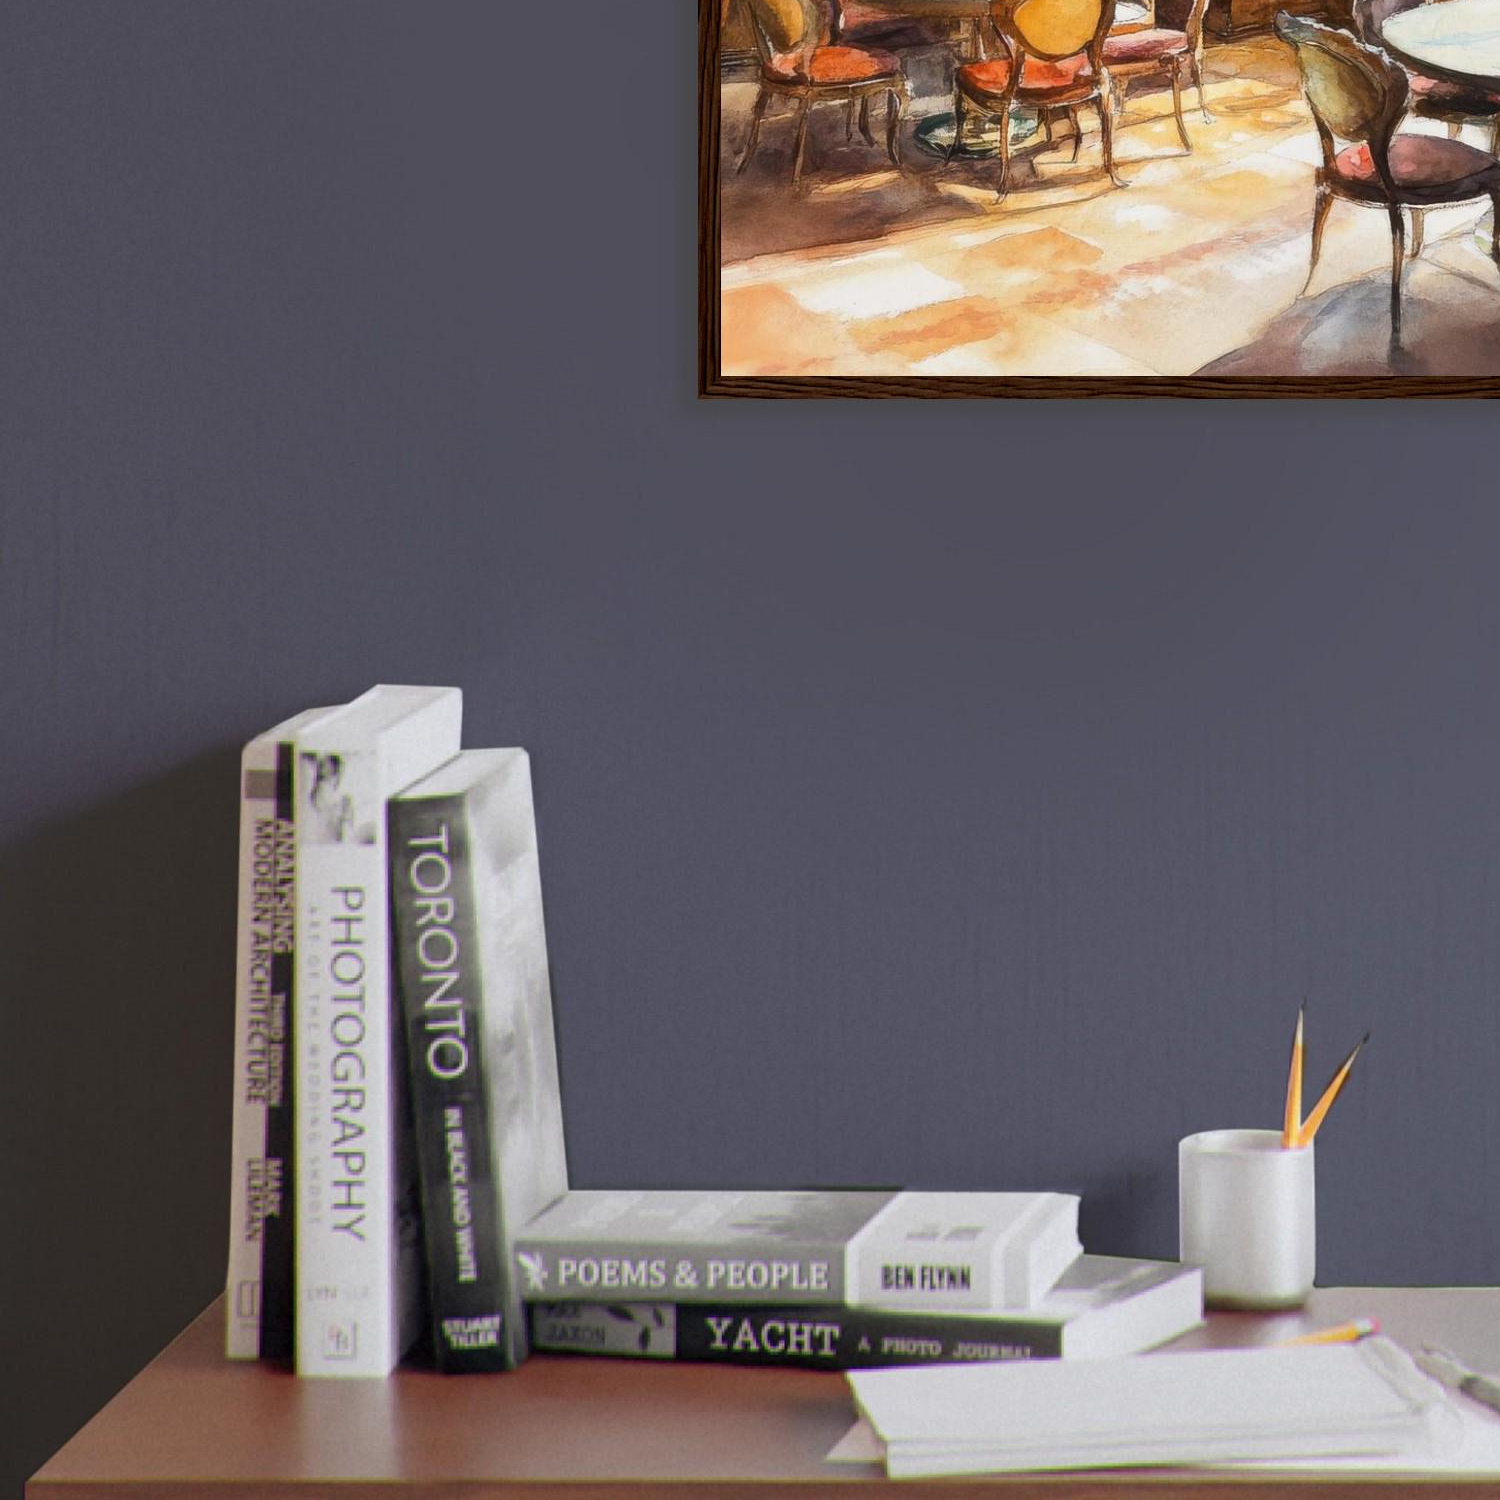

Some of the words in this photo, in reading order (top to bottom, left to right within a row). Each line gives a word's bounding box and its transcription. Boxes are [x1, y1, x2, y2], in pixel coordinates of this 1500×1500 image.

[252, 819, 274, 924] MODERN
[407, 824, 469, 1080] TORONTO
[246, 931, 272, 1105] ARCHITECTURE
[330, 885, 367, 1242] PHOTOGRAPHY
[557, 1258, 667, 1289] POEMS
[674, 1260, 698, 1288] &
[706, 1261, 829, 1291] PEOPLE
[881, 1264, 914, 1291] BEN
[919, 1264, 971, 1291] FLYNN
[705, 1315, 841, 1357] YACHT
[881, 1336, 943, 1358] PHOTO
